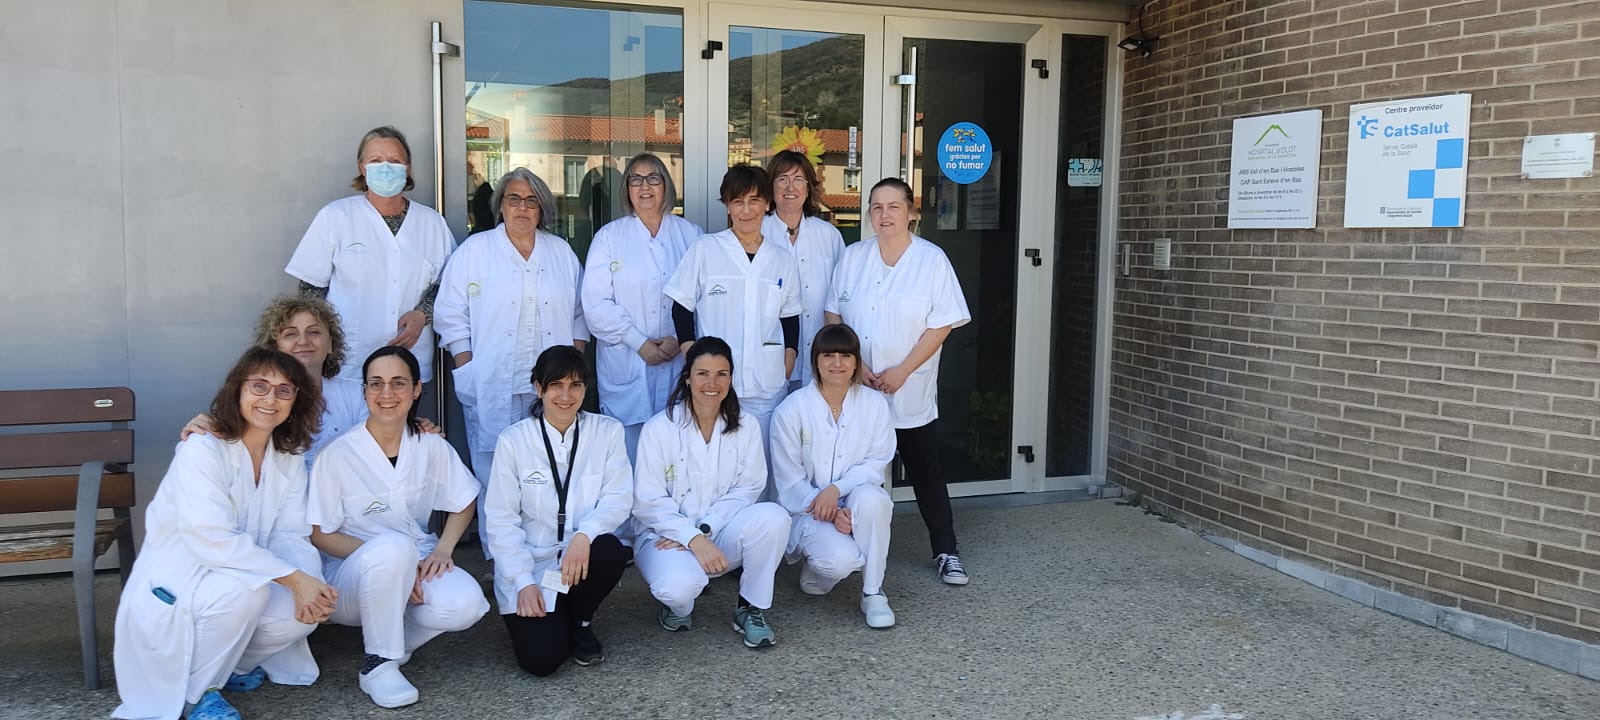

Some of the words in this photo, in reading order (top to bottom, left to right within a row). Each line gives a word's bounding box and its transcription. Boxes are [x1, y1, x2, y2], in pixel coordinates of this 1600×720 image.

[1385, 105, 1408, 114] Centre
[1408, 103, 1443, 113] proveïdor
[1383, 121, 1449, 138] CatSalut
[945, 144, 962, 152] fem
[964, 143, 986, 152] salut
[959, 161, 984, 169] fumar
